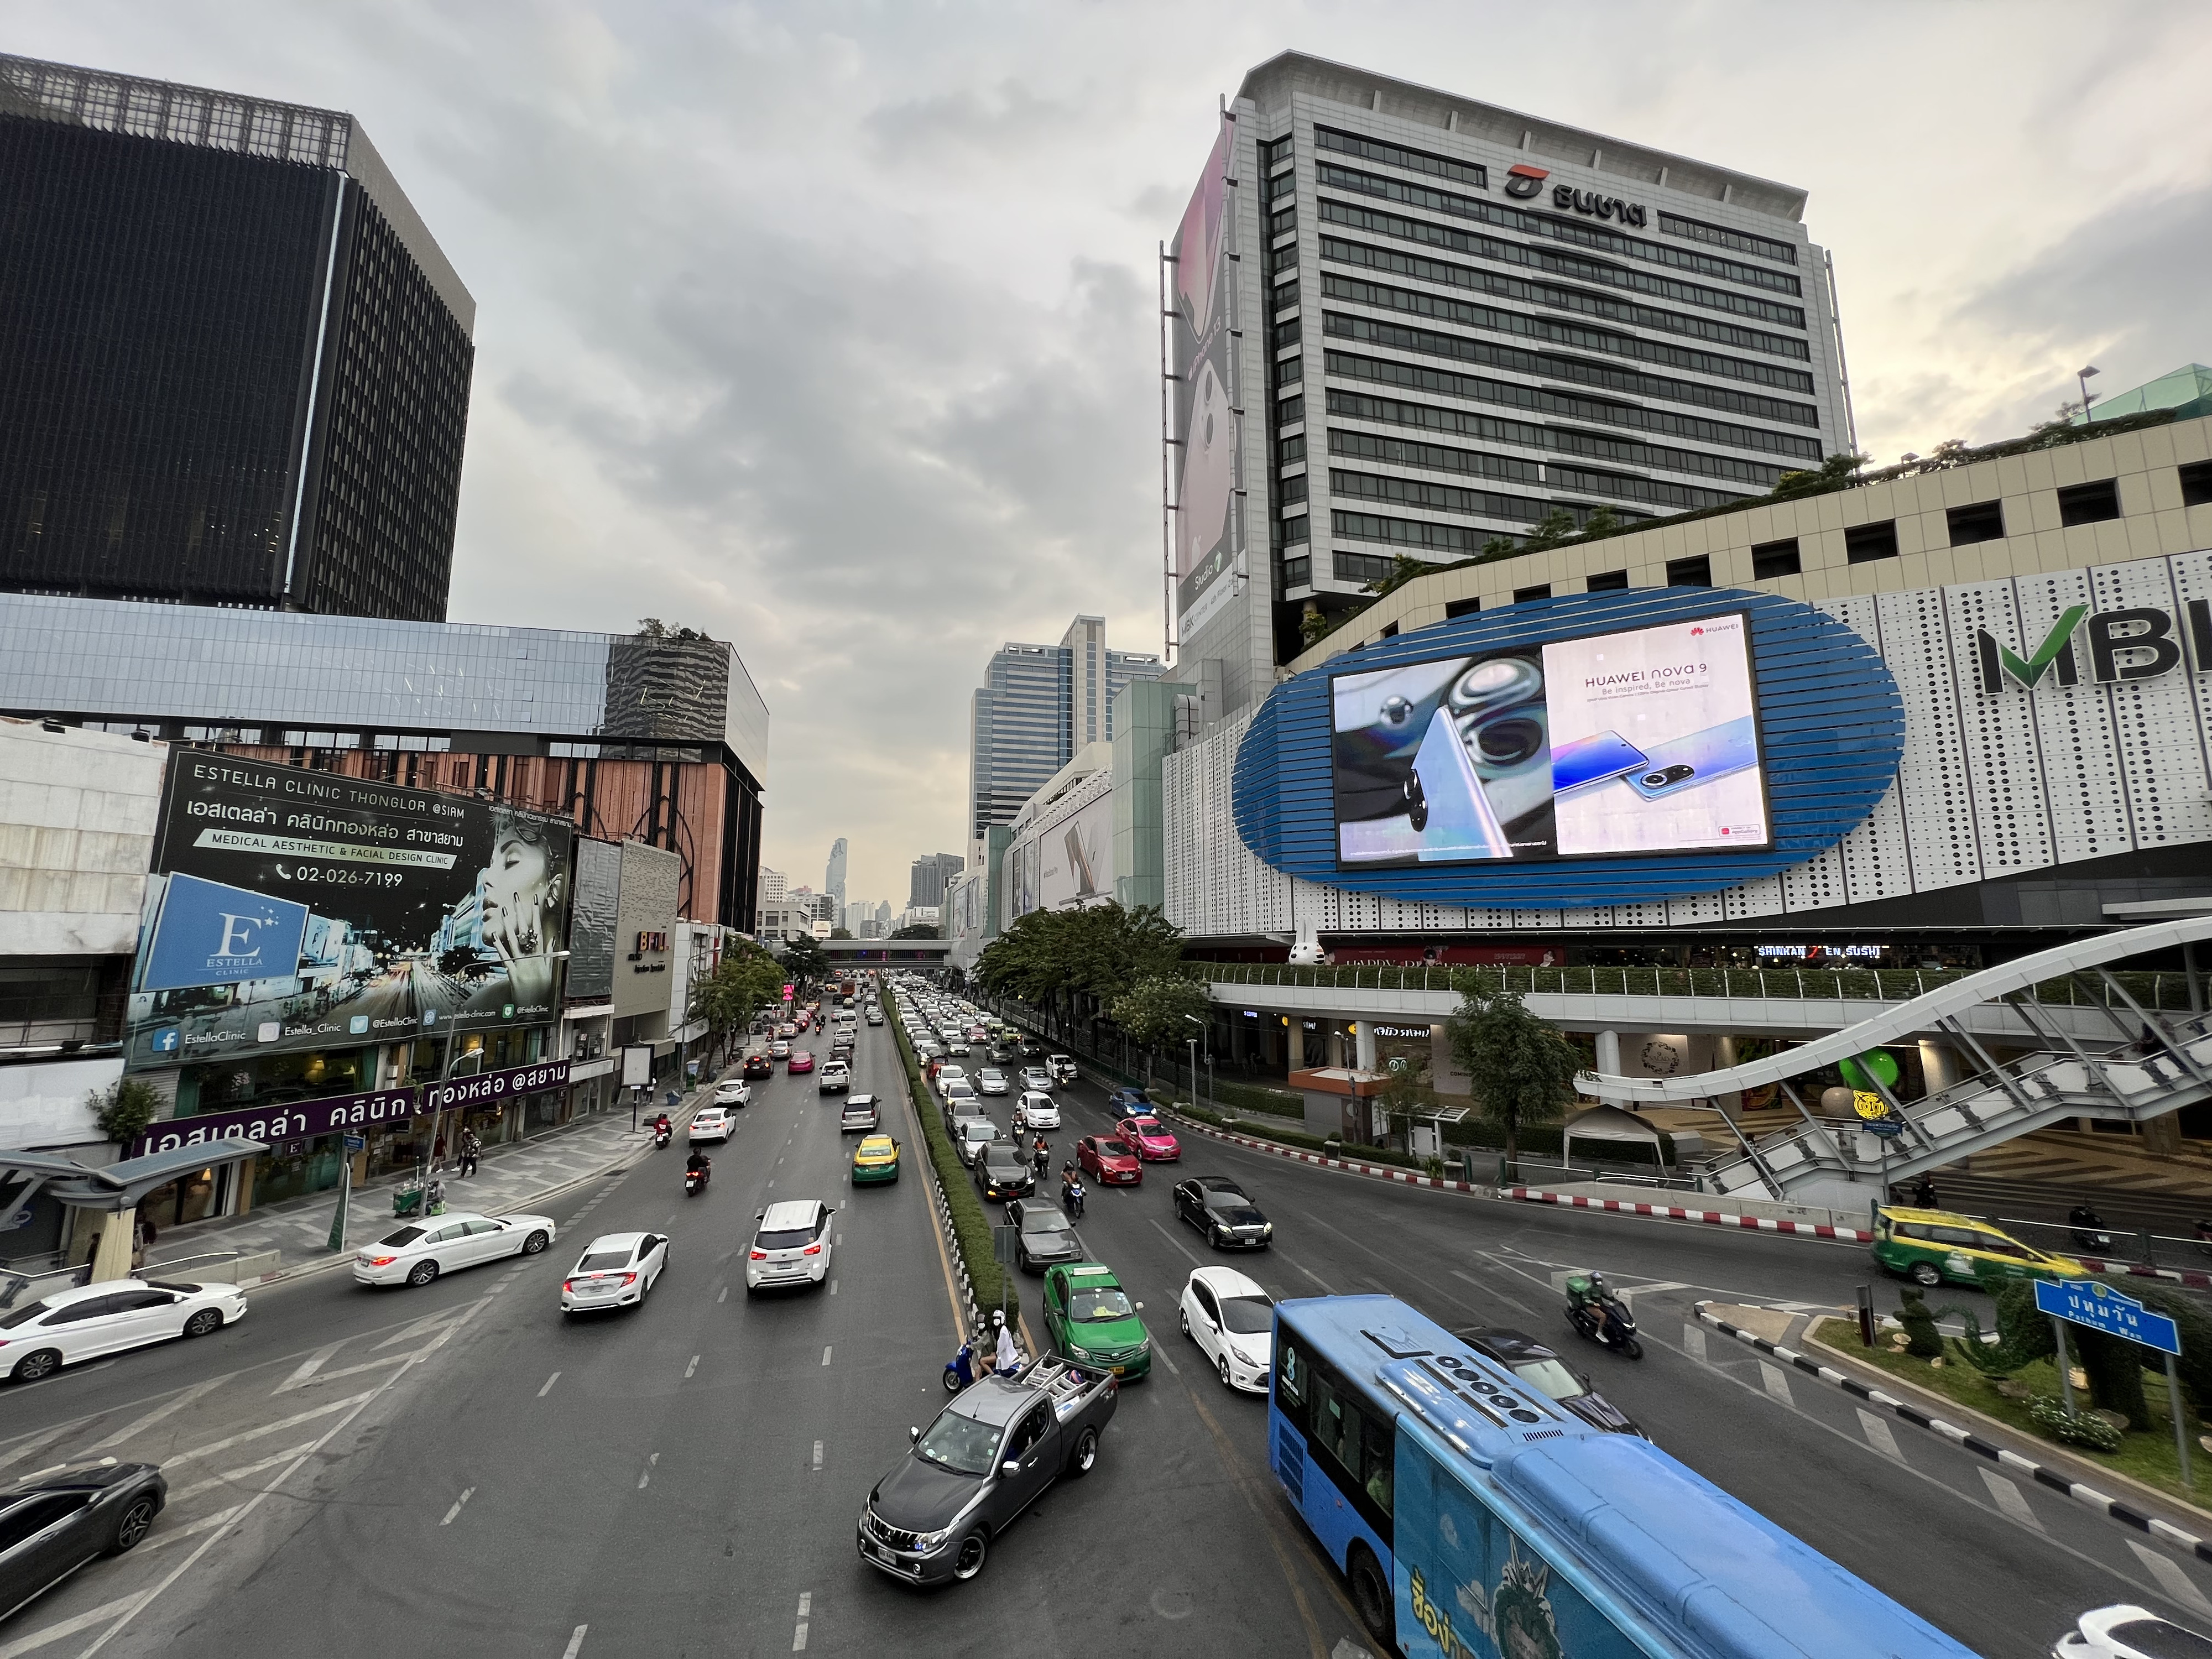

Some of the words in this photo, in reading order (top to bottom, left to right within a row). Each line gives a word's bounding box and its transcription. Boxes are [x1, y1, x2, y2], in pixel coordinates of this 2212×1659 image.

[1553, 184, 1647, 228] ธนชาต
[1192, 332, 1213, 374] iPhone
[1213, 316, 1220, 336] 13
[1194, 564, 1213, 590] Studio
[1181, 614, 1194, 637] MBK
[1706, 623, 1739, 634] HUAWEI
[1585, 671, 1645, 688] HUAWEI
[1651, 664, 1694, 680] nova
[1699, 663, 1707, 673] 9
[1615, 682, 1652, 694] inspired,
[1669, 678, 1691, 686] nova
[194, 764, 276, 789] ESTELLA
[285, 780, 340, 800] CLINIC
[349, 790, 426, 812] THONGLOR
[432, 804, 465, 819] @SIAM
[187, 801, 276, 825] เอสเตลล่า
[287, 813, 399, 839] คลินิกทองหล่อ
[406, 828, 463, 847] สาขาสยาม
[212, 833, 267, 848] MEDICAL
[272, 840, 335, 855] AESTHETIC
[340, 847, 347, 856] &
[351, 848, 384, 860] FACIAL
[389, 852, 422, 862] DESIGN
[426, 855, 448, 864] CLINIC
[297, 866, 403, 887] 02-026-7199
[210, 912, 262, 957] E
[207, 957, 263, 968] ESTELLA
[1846, 947, 1880, 956] SUSHI
[216, 968, 249, 976] CLINIC
[372, 1016, 418, 1028] @EstellaClinic
[438, 1010, 496, 1021] wwwestella-clinic.com
[185, 1031, 246, 1044] EstellaClinic
[284, 1024, 341, 1036] Estella_Clinic
[330, 1097, 405, 1126] คลินิก
[512, 1066, 566, 1091] @สยาม
[2068, 1295, 2138, 1327] ปทุมวัน
[2068, 1311, 2106, 1329] Pathum
[2119, 1327, 2142, 1340] Wan
